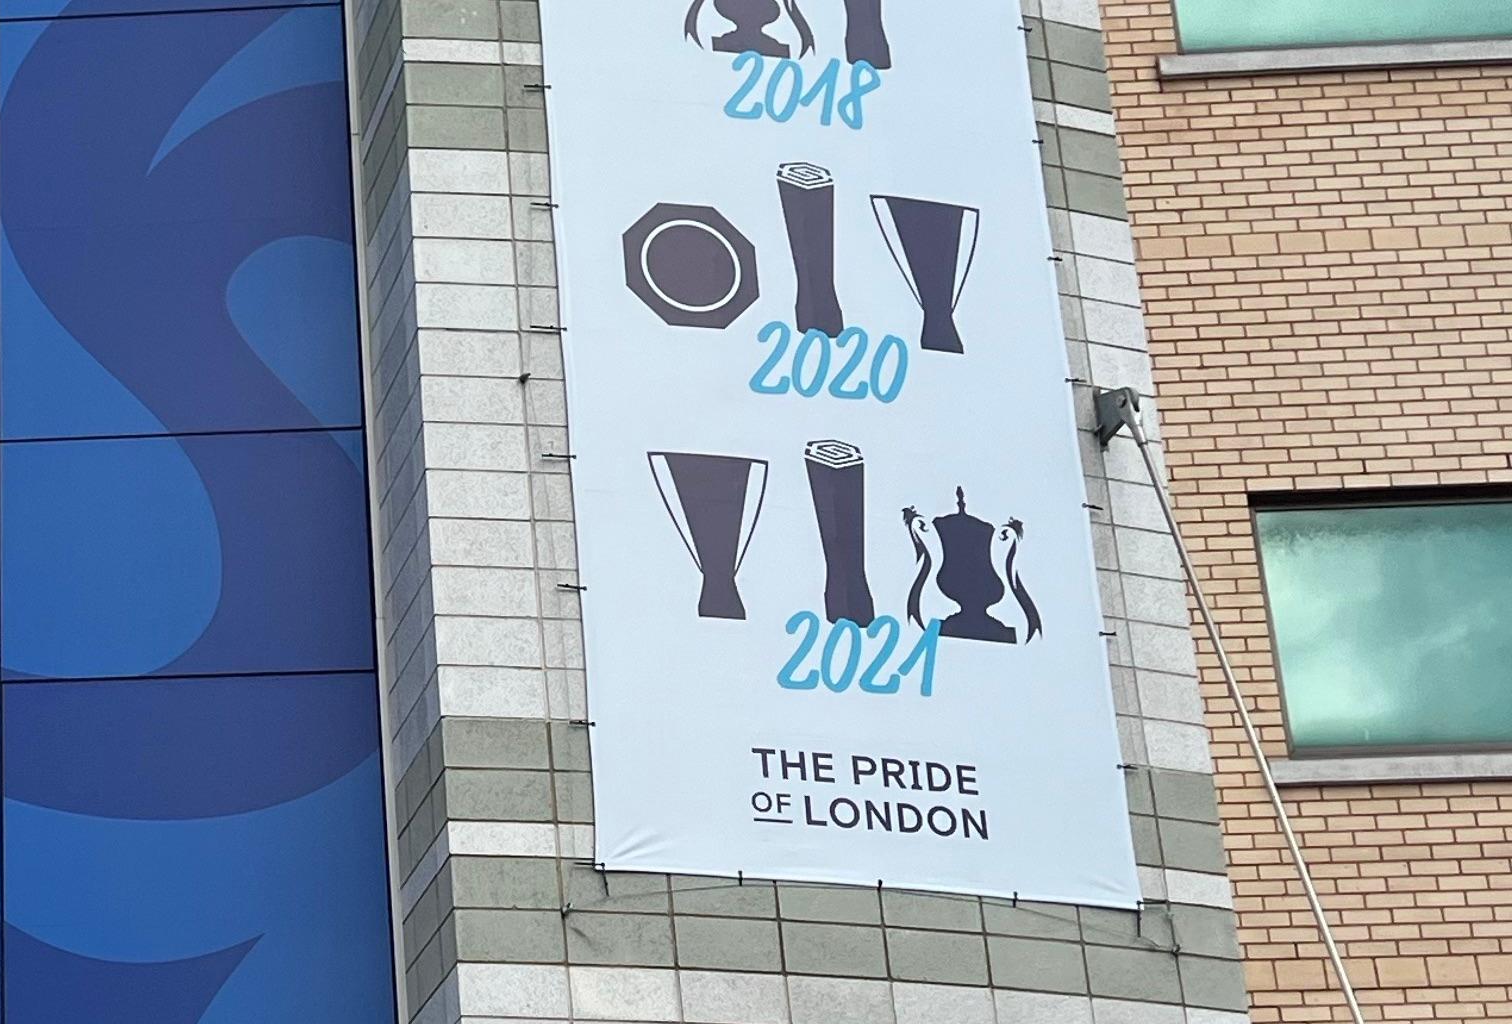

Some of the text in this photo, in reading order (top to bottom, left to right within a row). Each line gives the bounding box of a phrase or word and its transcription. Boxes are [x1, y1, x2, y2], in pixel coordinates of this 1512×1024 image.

[724, 50, 882, 130] 2018
[749, 320, 909, 404] 2020
[777, 610, 943, 697] 2021
[751, 747, 980, 796] THE PRIDE
[751, 791, 990, 841] OF LONDON
